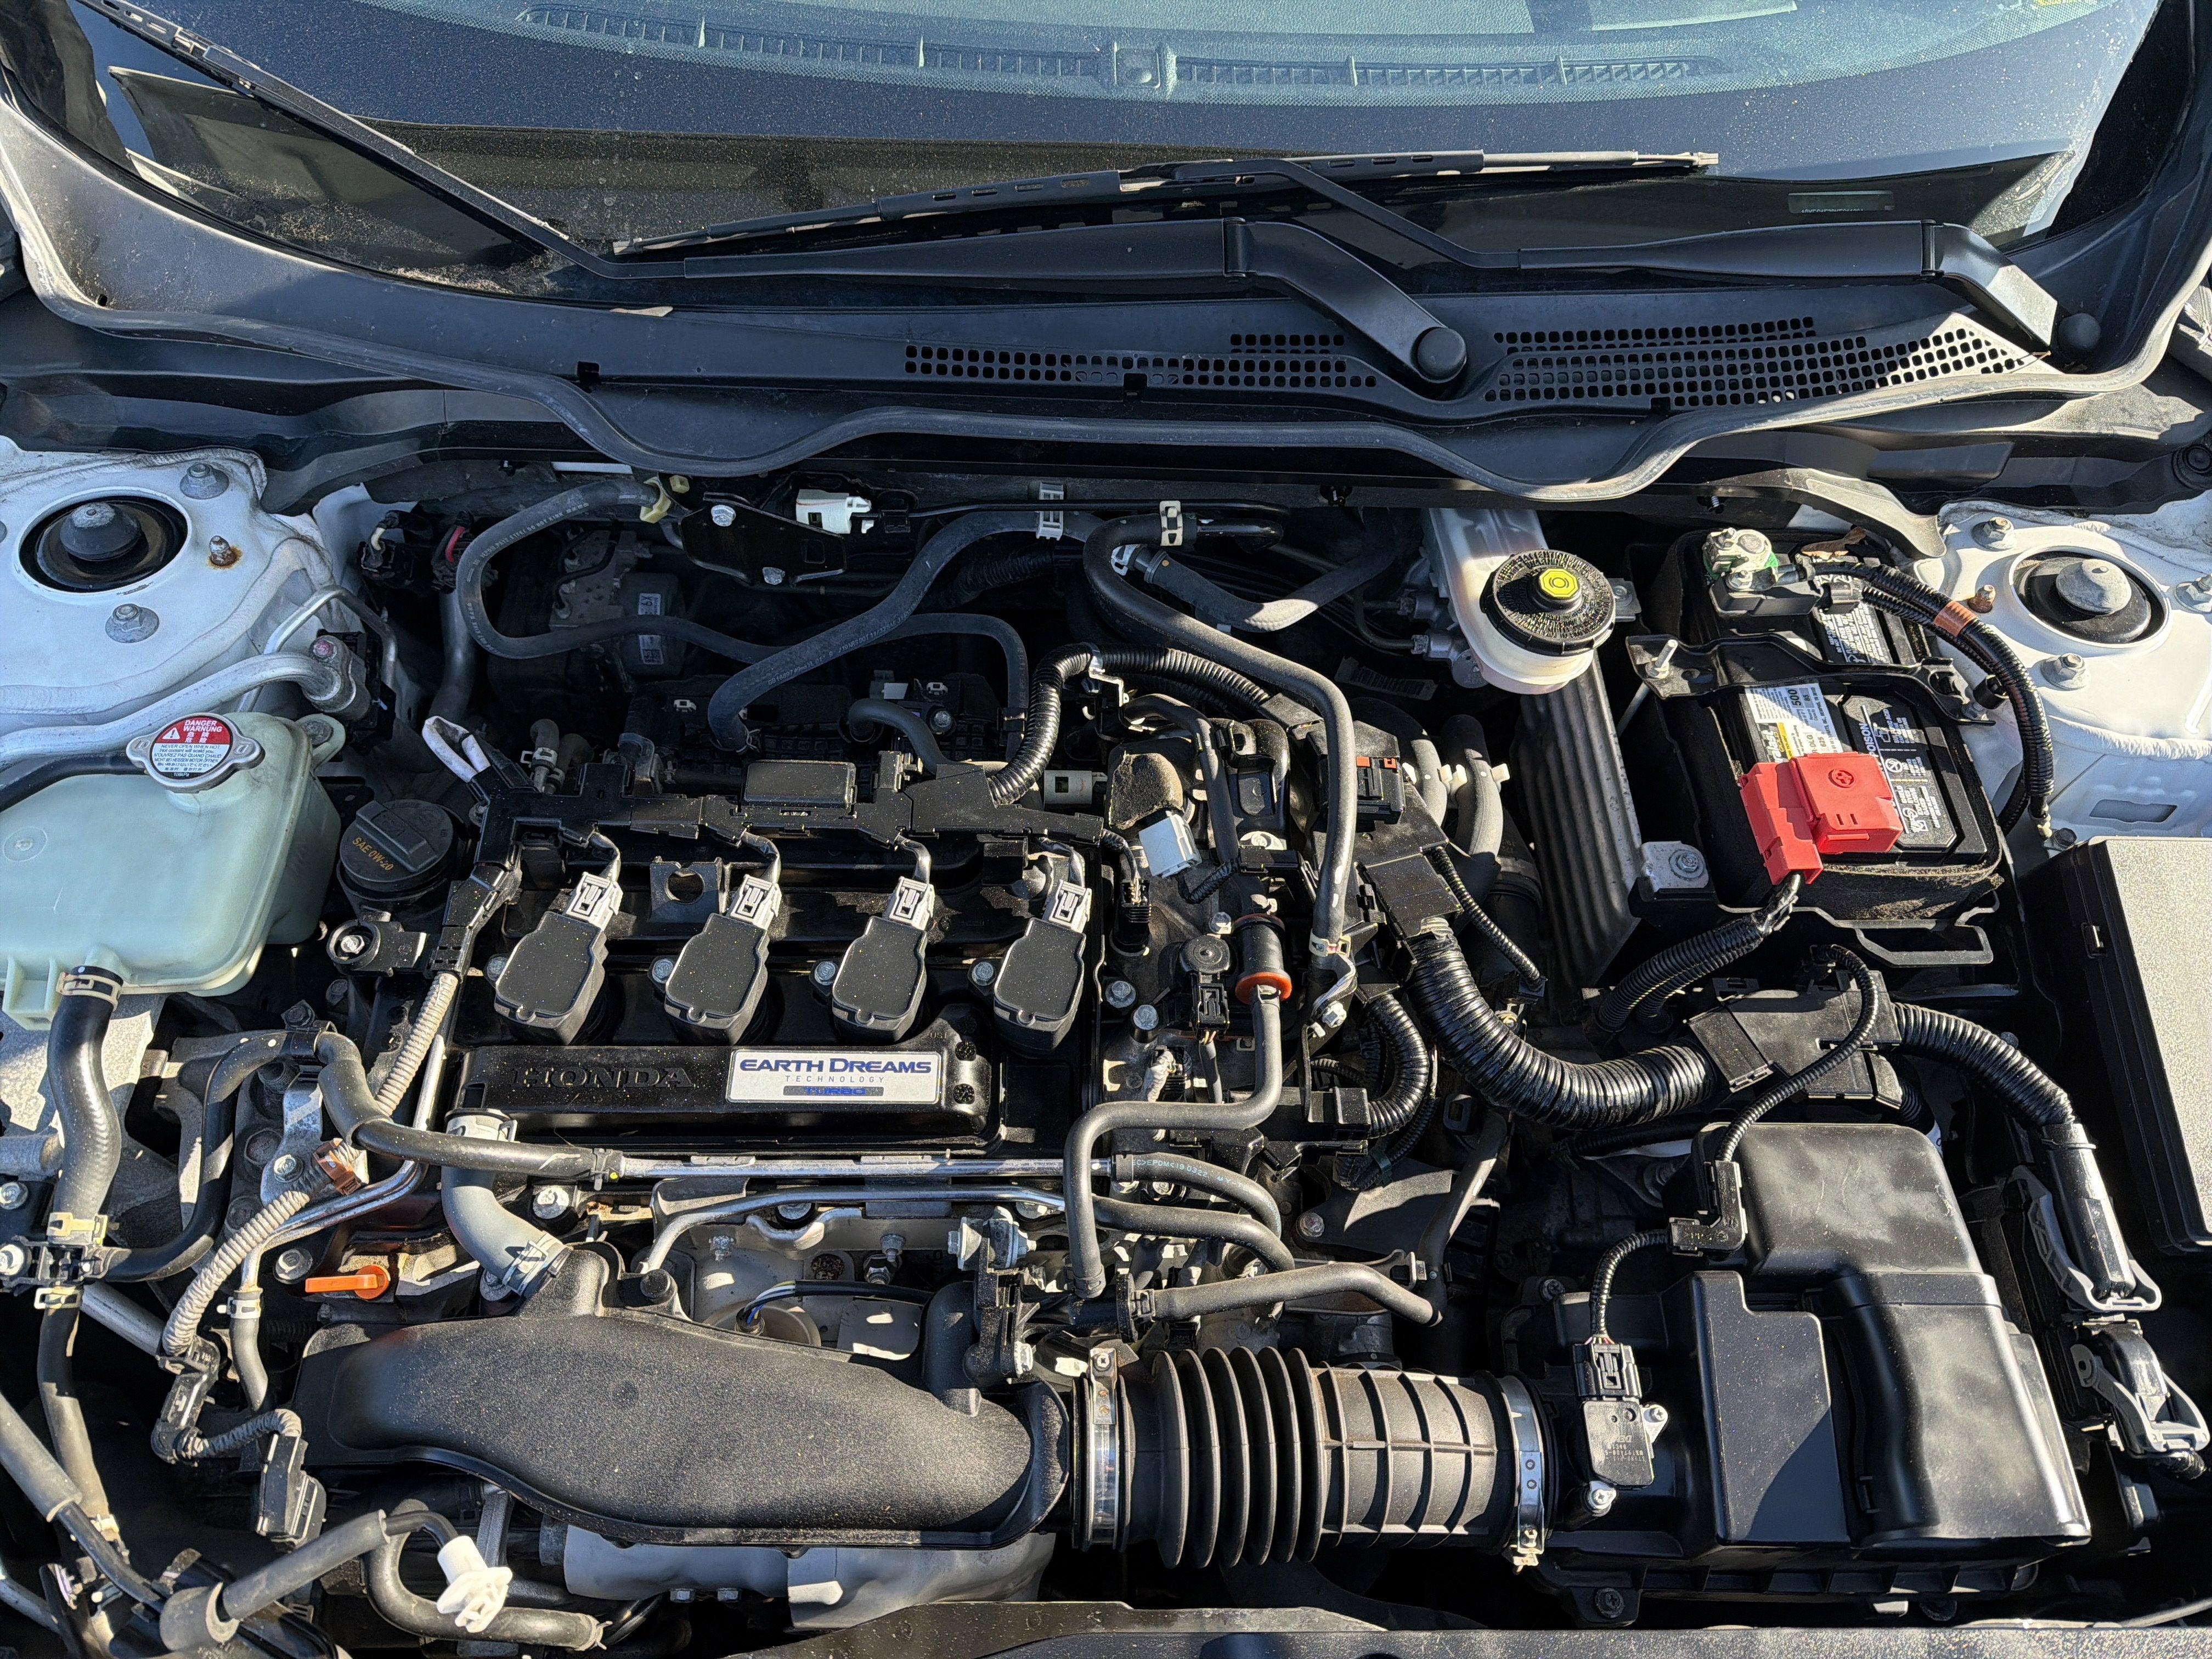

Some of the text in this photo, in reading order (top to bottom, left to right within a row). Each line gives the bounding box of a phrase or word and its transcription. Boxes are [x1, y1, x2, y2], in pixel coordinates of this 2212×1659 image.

[1787, 689, 1801, 706] 500
[1882, 709, 1892, 719] ACID
[1818, 738, 1826, 746] 625
[1860, 723, 1878, 756] POISON
[1895, 785, 1908, 803] SHIELD
[1904, 790, 1914, 803] EYES
[352, 837, 394, 871] SAE 0W-20
[740, 1058, 932, 1074] EARTH DREAMS
[510, 1068, 696, 1088] HONDA
[785, 1075, 885, 1084] TECHNOLOGY
[805, 1087, 866, 1095] TURBO
